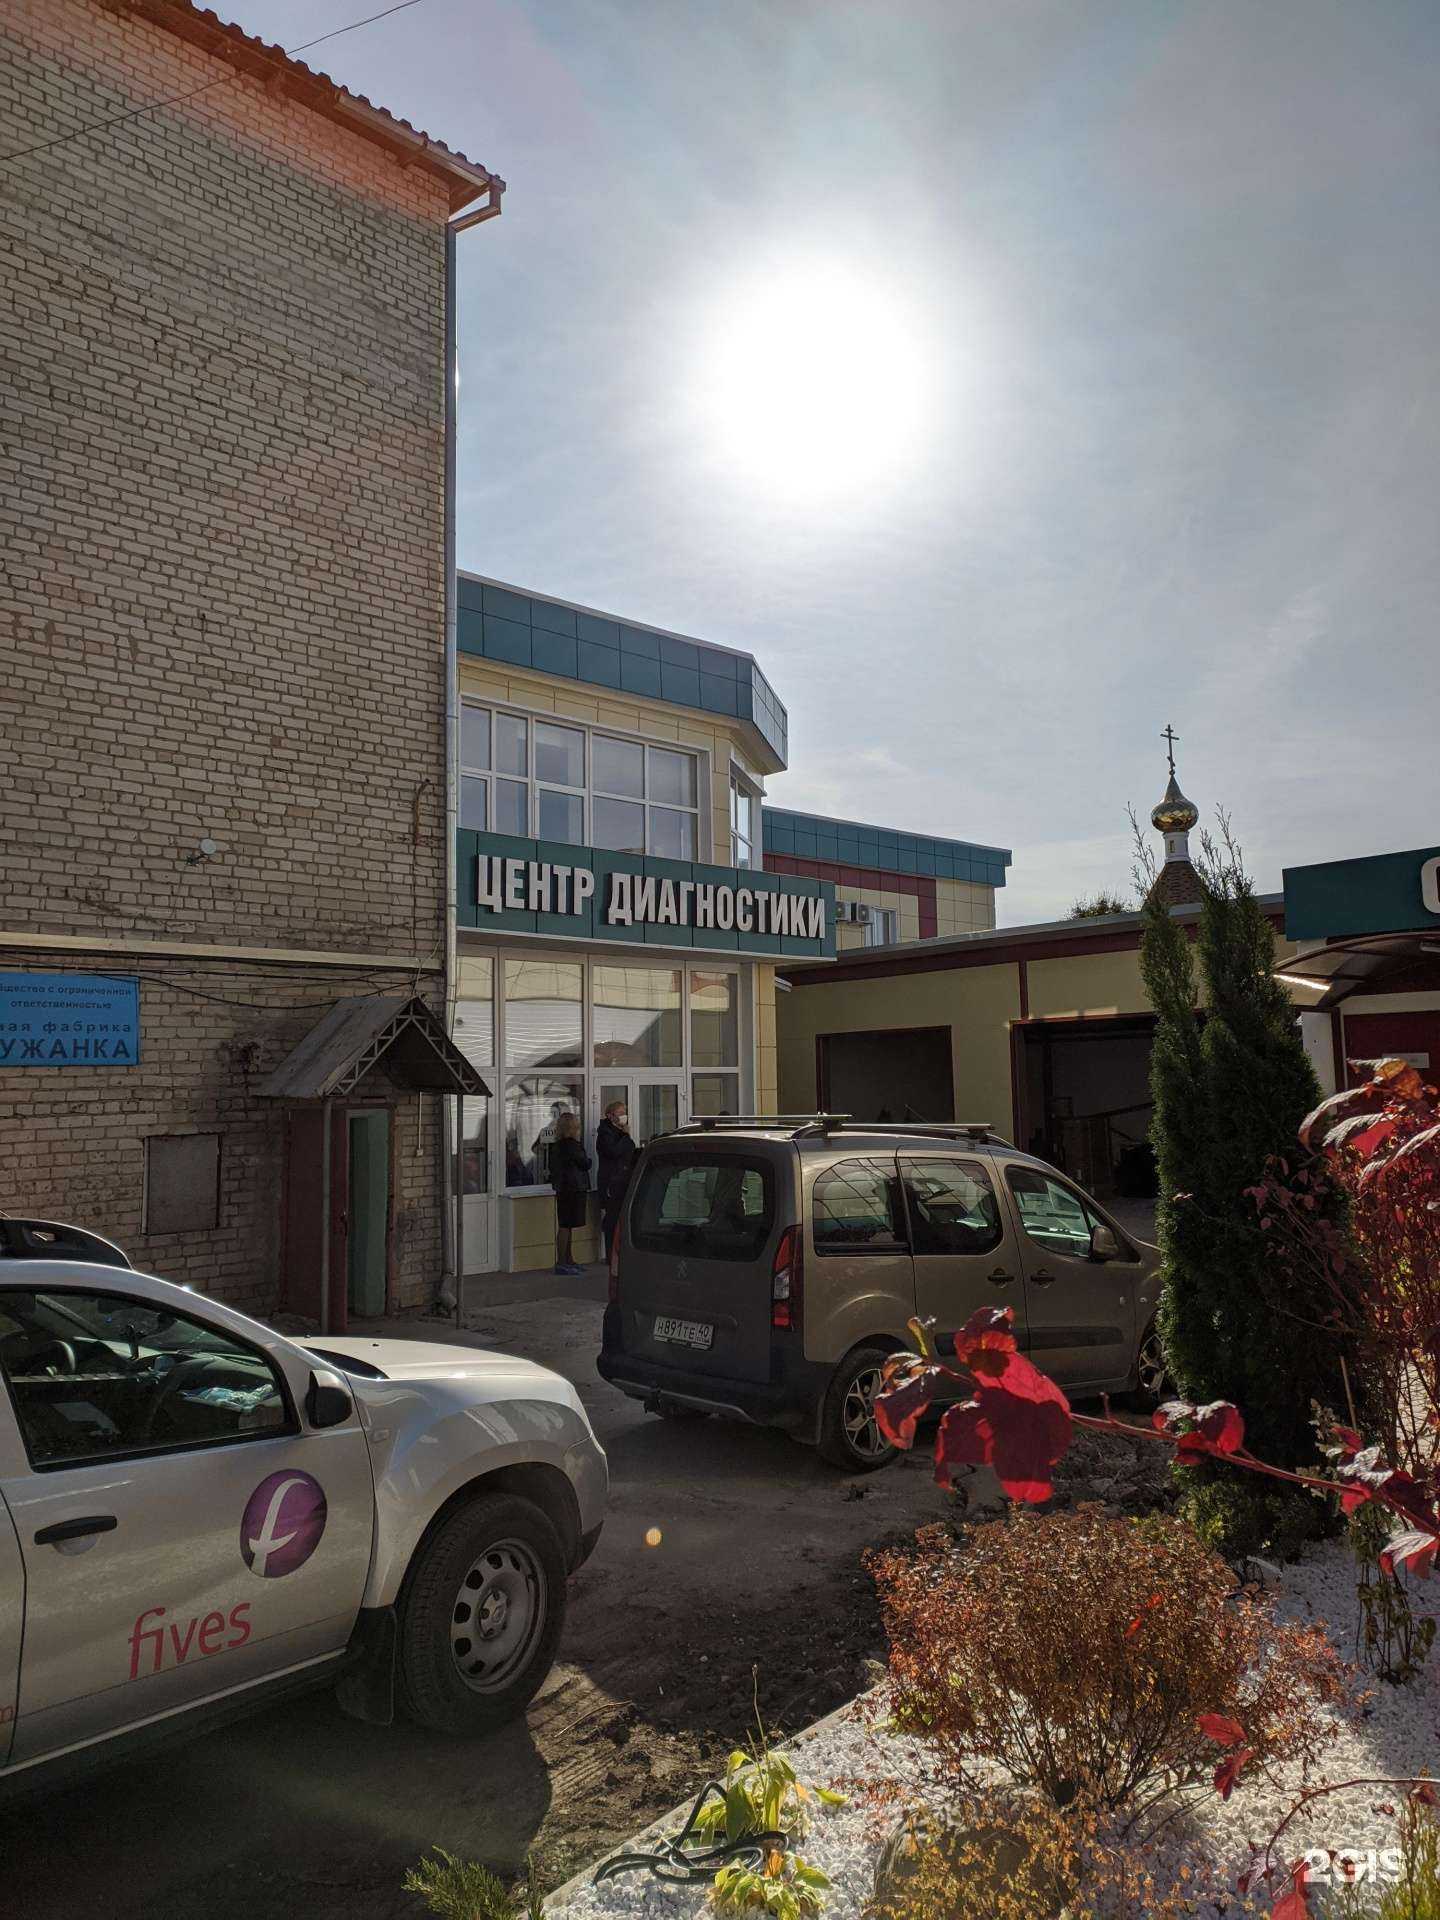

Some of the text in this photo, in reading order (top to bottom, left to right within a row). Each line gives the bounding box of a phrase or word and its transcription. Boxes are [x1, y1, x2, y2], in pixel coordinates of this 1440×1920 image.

[478, 854, 825, 939] ЦЕНТР ДИАГНОСТИКИ
[0, 1038, 130, 1059] УЖАНКА
[42, 1020, 131, 1034] фабрика
[128, 1602, 251, 1681] fives
